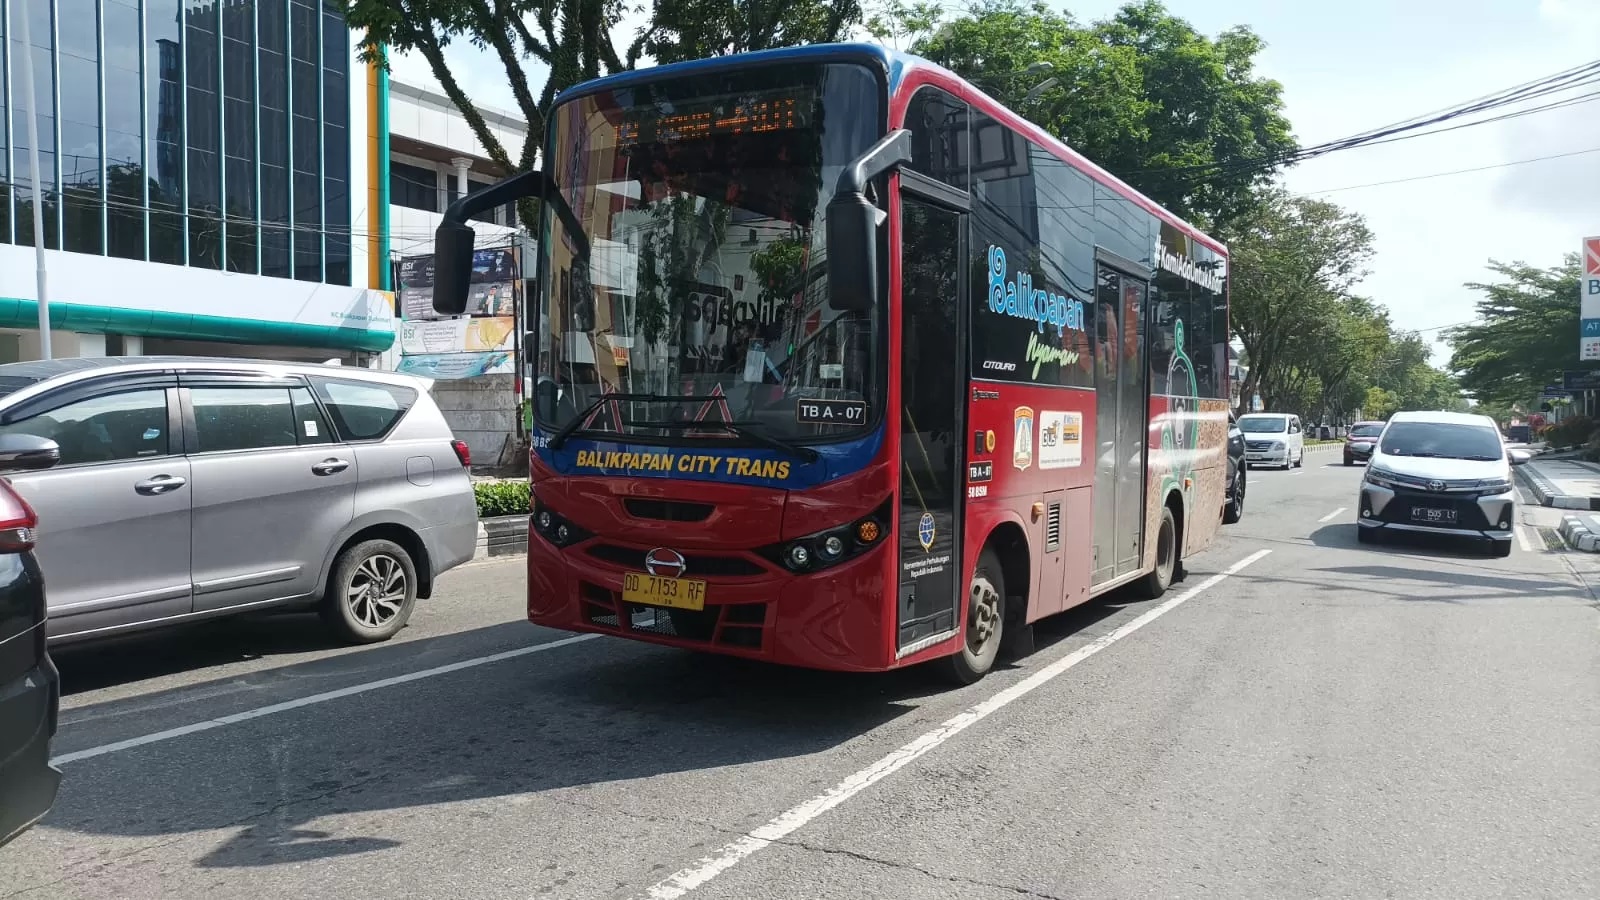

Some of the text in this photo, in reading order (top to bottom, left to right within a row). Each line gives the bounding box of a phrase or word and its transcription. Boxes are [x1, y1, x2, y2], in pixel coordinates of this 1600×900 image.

[402, 262, 414, 270] BSI
[988, 244, 1085, 337] Balikpapan
[403, 328, 415, 339] BSI
[1025, 331, 1080, 380] Nyaman
[982, 360, 1017, 371] CITOURO
[846, 407, 862, 419] 07
[576, 450, 791, 479] BALIKPAPAN CITY TRANS
[625, 575, 703, 600] DD 7153 RF
